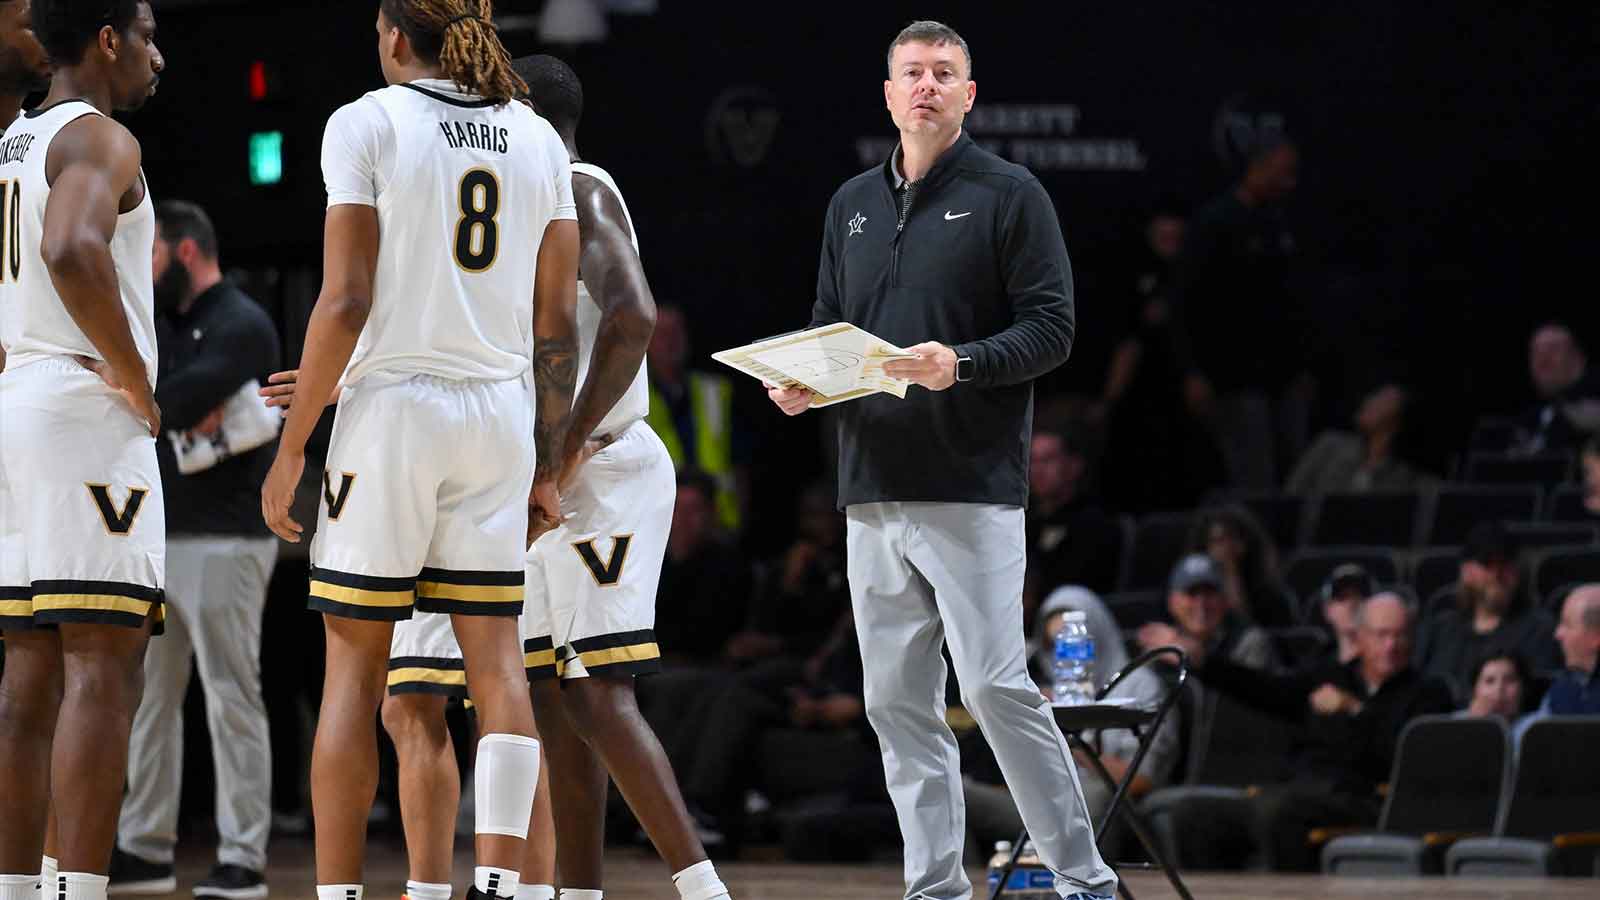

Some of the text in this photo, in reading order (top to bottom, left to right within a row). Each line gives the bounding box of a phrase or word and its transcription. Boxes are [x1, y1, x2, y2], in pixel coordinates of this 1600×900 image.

[440, 121, 508, 154] HARRIS
[454, 168, 499, 272] 8
[85, 482, 148, 536] V
[571, 533, 633, 587] V
